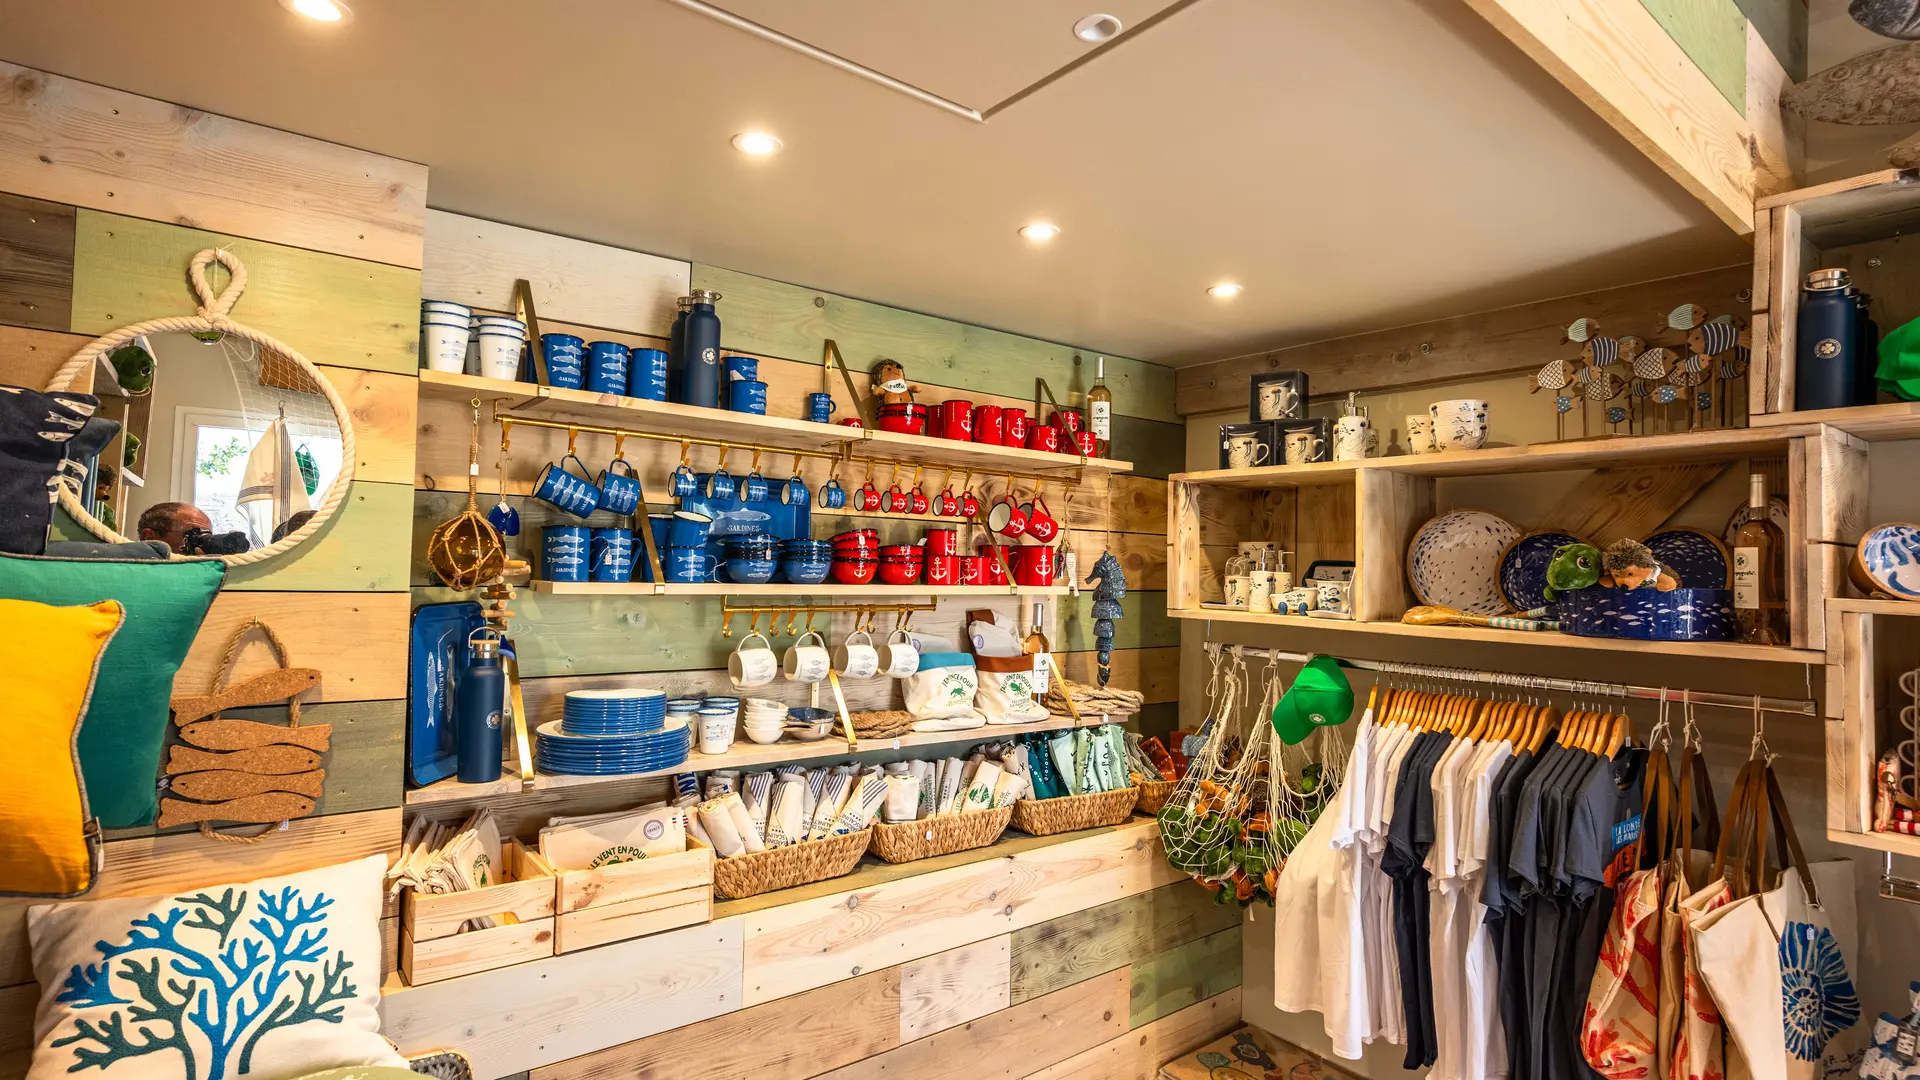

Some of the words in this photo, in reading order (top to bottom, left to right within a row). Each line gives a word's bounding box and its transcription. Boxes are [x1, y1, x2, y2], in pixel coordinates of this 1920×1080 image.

[1616, 826, 1621, 836] LA
[590, 859, 600, 868] LE
[597, 847, 616, 861] VENT
[618, 846, 627, 854] EN
